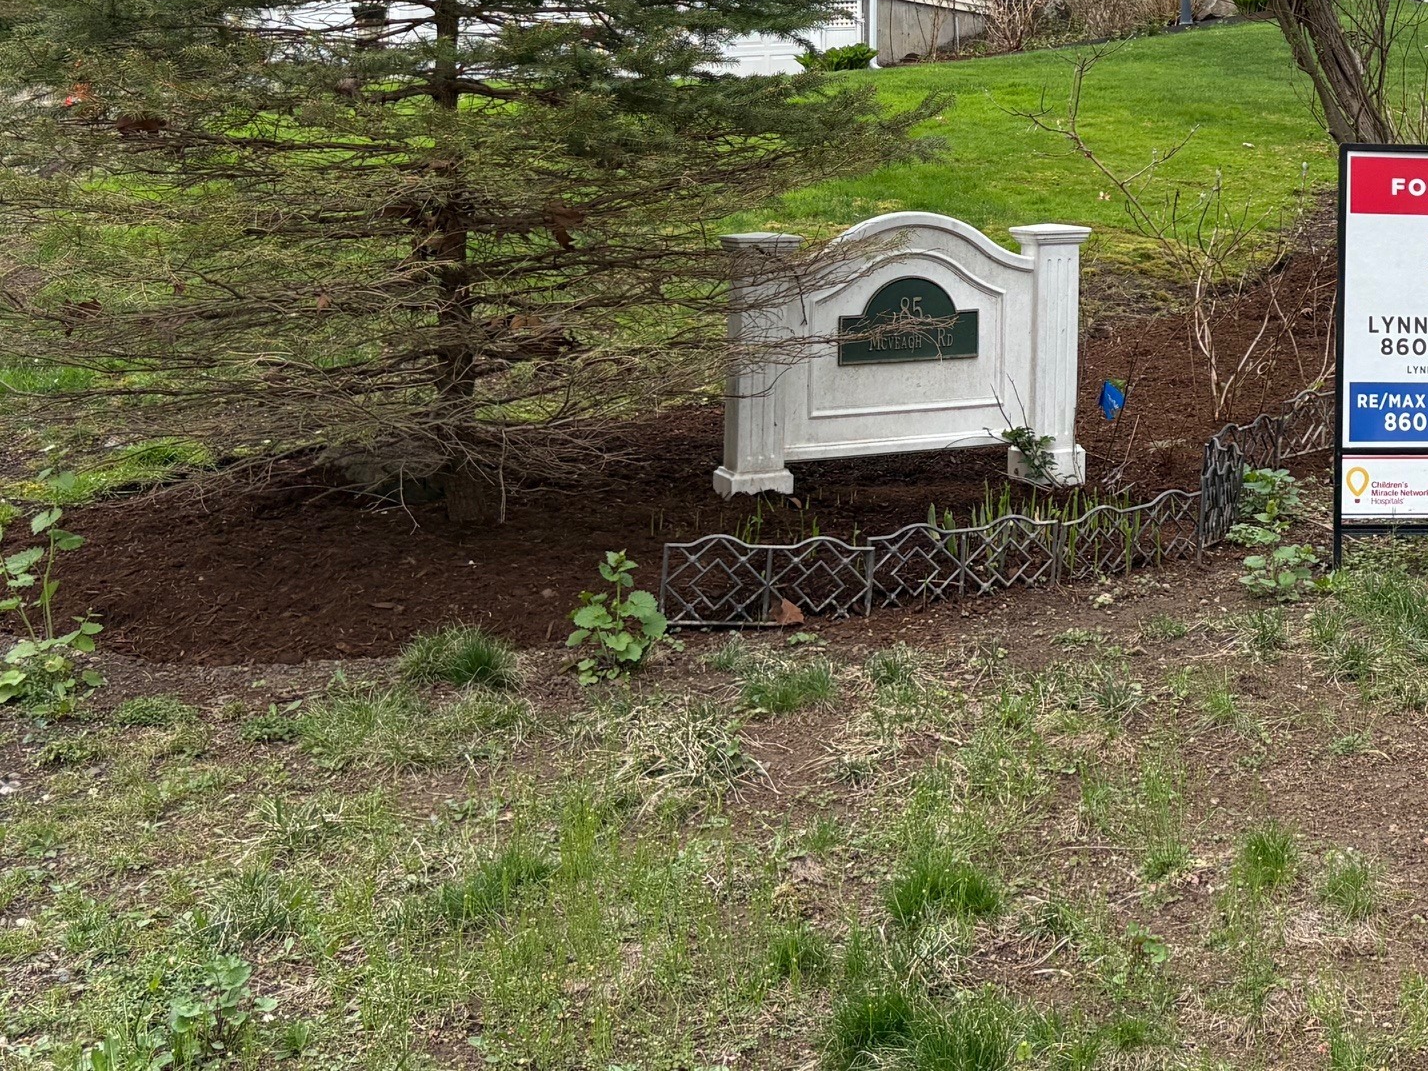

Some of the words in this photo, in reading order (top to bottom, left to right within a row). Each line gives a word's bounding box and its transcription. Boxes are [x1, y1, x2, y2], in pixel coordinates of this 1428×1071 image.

[900, 296, 922, 323] 85
[1368, 316, 1428, 334] LYNN
[1357, 393, 1426, 409] RE/MAX
[1371, 481, 1408, 489] Children's
[1371, 489, 1398, 497] Miracle
[1371, 497, 1404, 506] Hospitals
